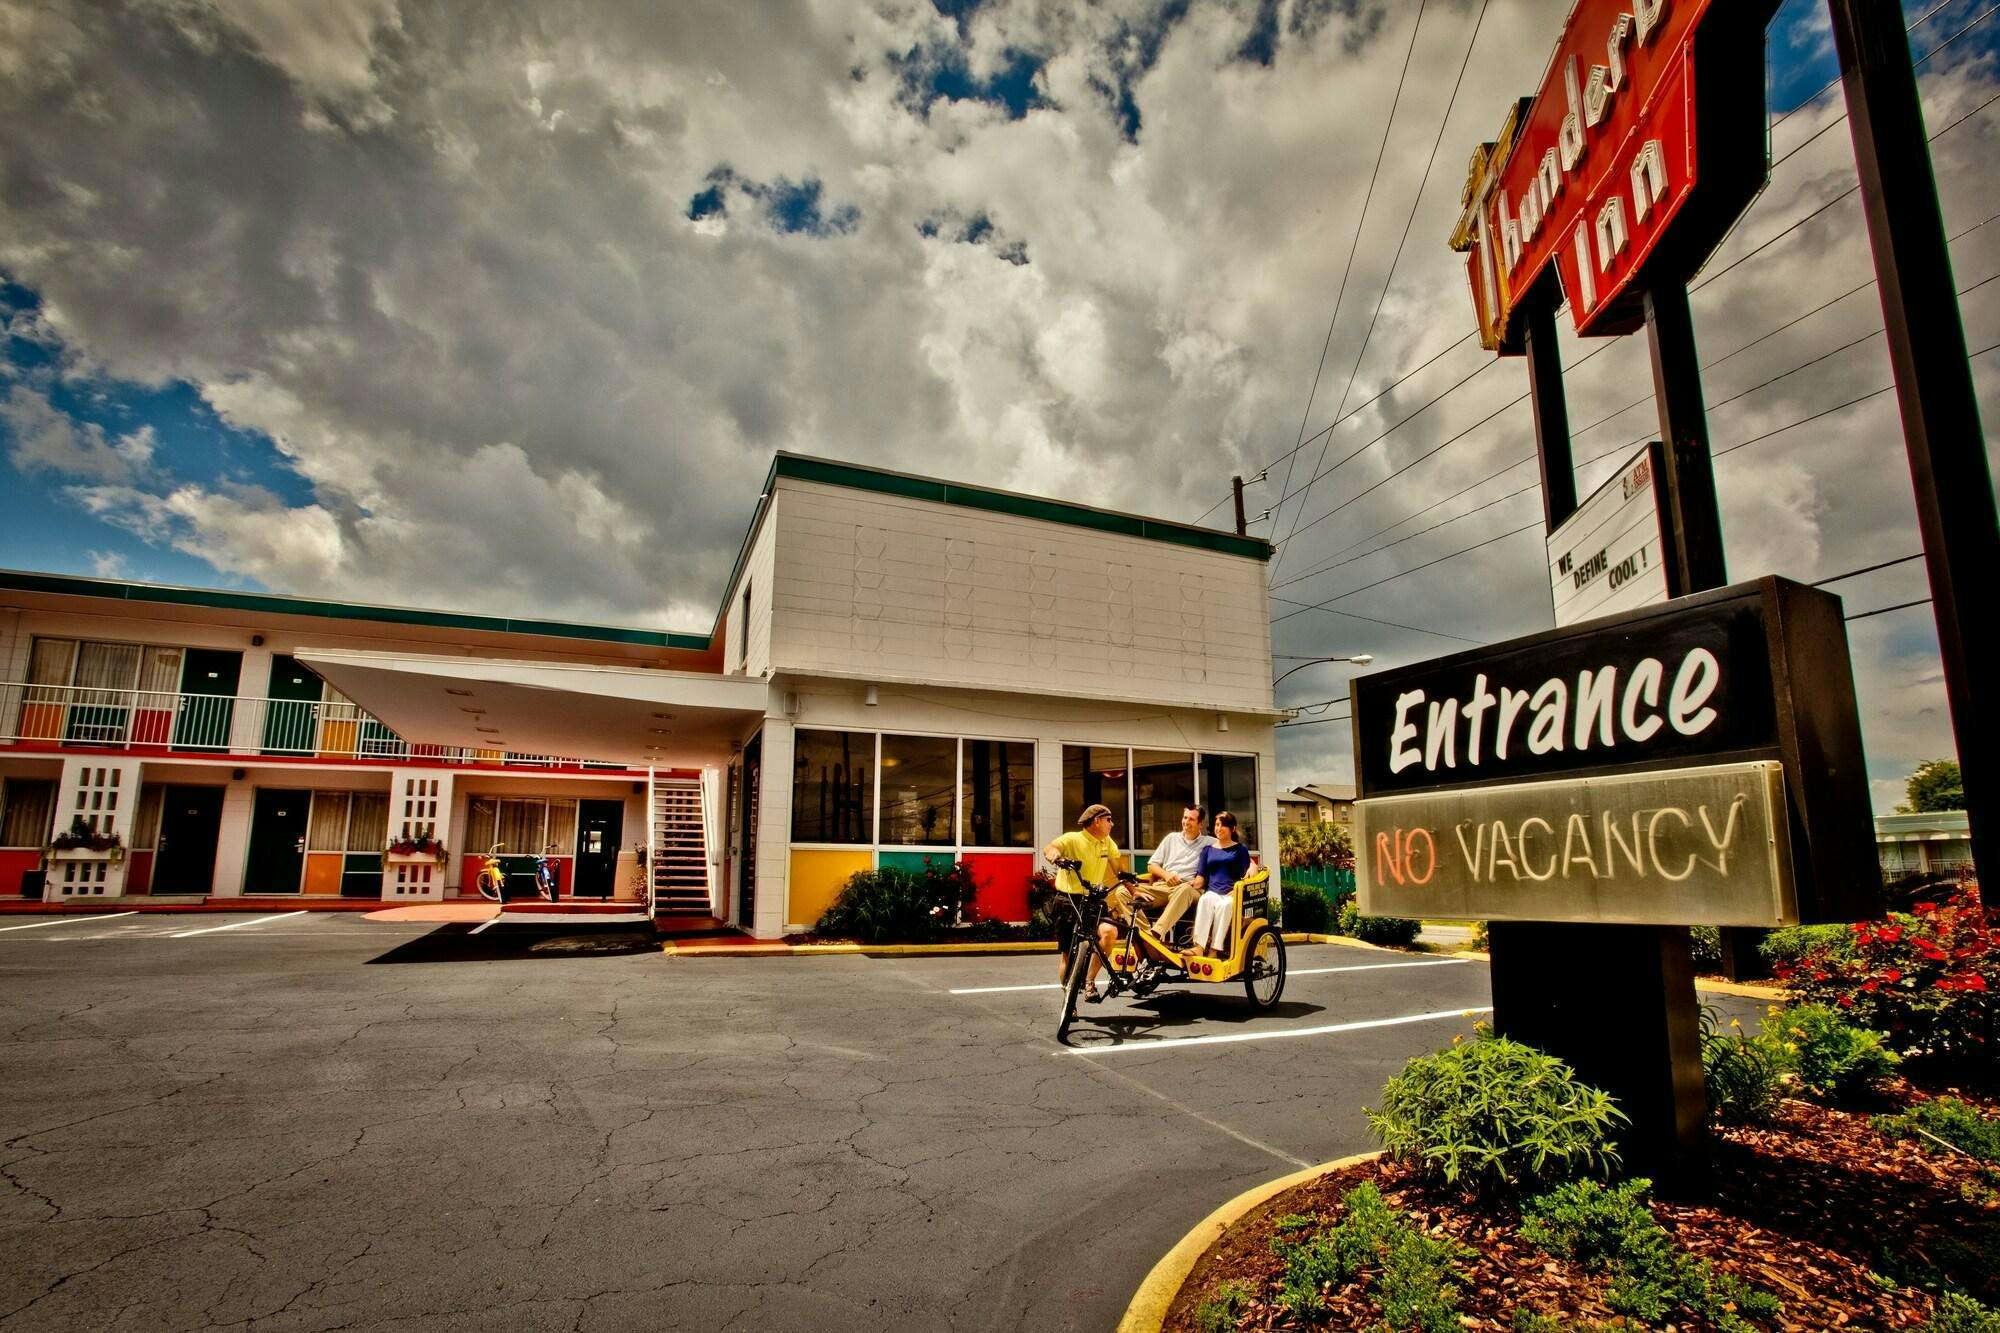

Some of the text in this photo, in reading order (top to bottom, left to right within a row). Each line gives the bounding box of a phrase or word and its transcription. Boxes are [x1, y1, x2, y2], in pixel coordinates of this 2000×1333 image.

[1574, 139, 1669, 314] Inn
[1558, 551, 1573, 576] WE
[1573, 548, 1608, 589] DEFINE
[1609, 554, 1638, 590] COOL
[1390, 647, 1720, 774] Entrance
[1376, 796, 1747, 889] NO VACANCY
